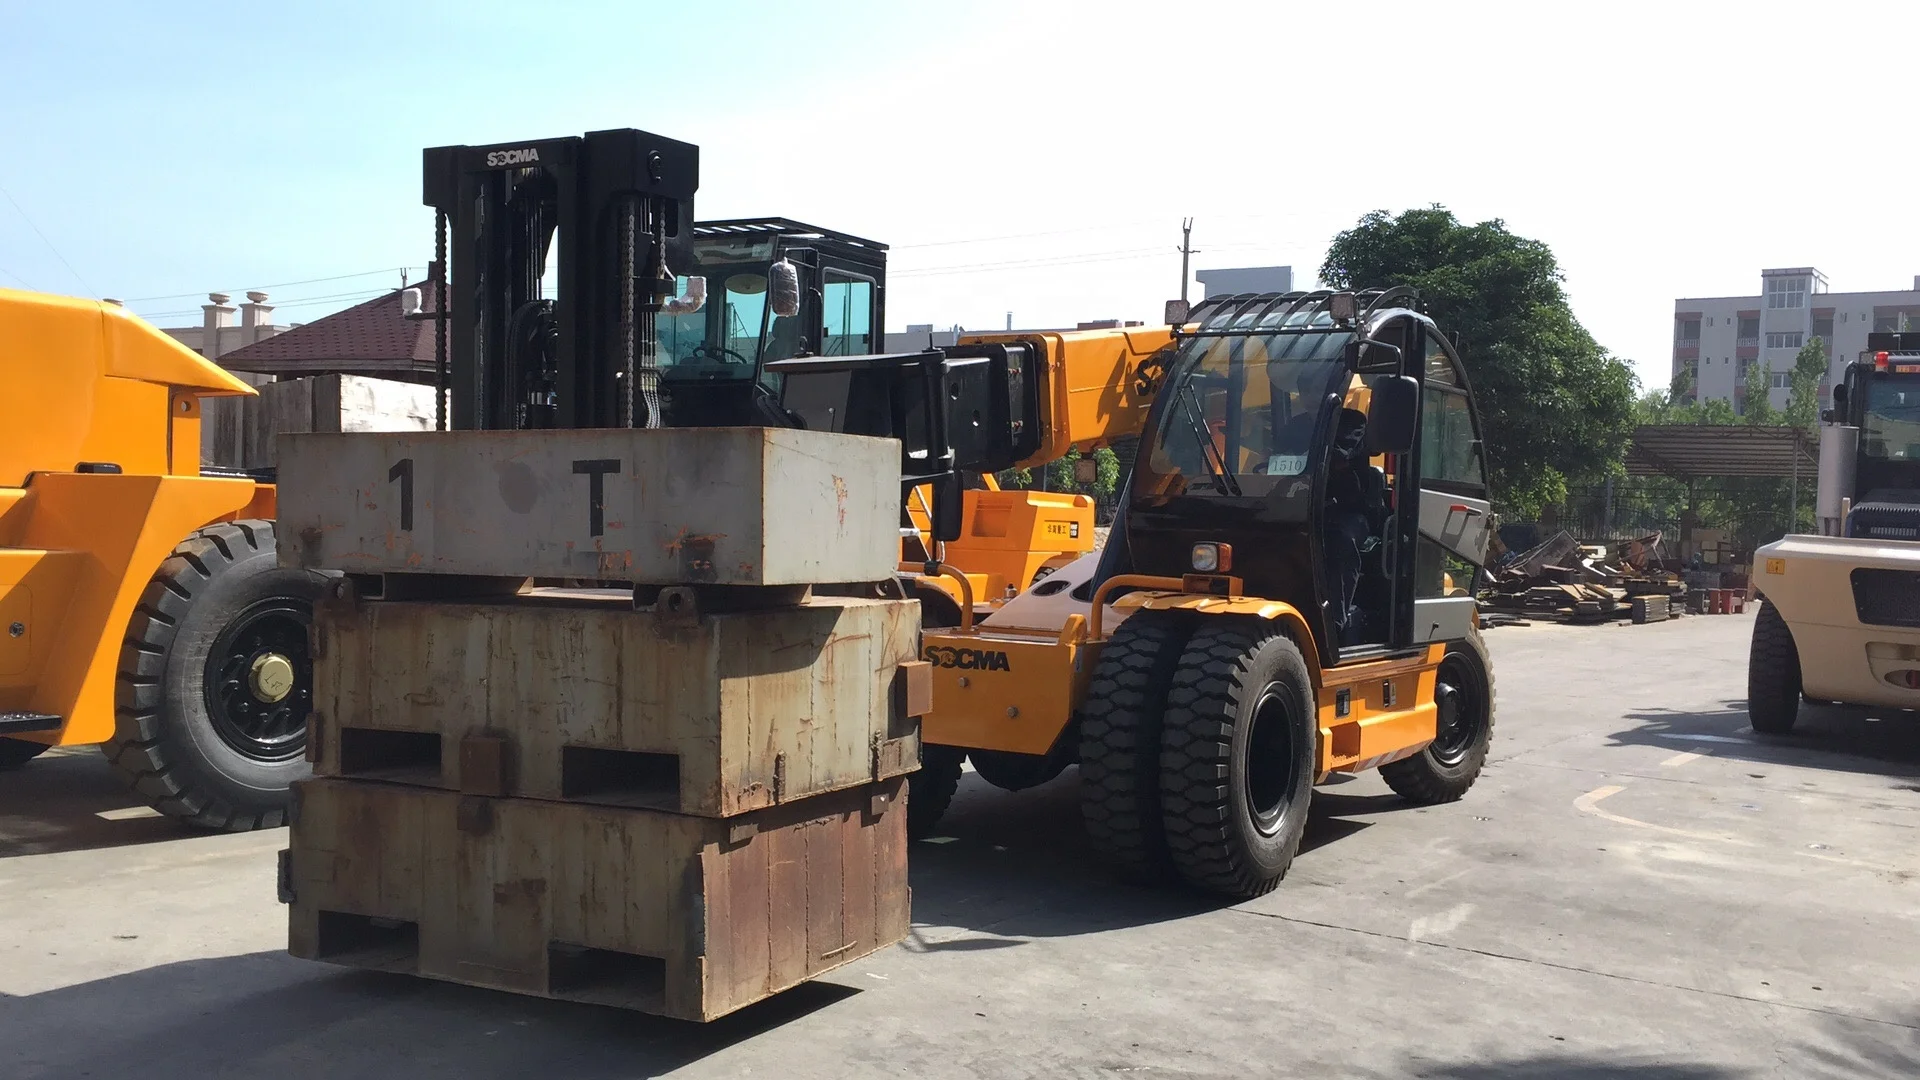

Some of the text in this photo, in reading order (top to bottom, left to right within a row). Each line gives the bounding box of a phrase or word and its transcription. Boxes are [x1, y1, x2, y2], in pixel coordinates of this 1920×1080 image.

[487, 148, 539, 166] SOCMA
[1273, 460, 1302, 472] 1510
[389, 458, 621, 537] 1 T
[925, 646, 1010, 672] SOCMA
